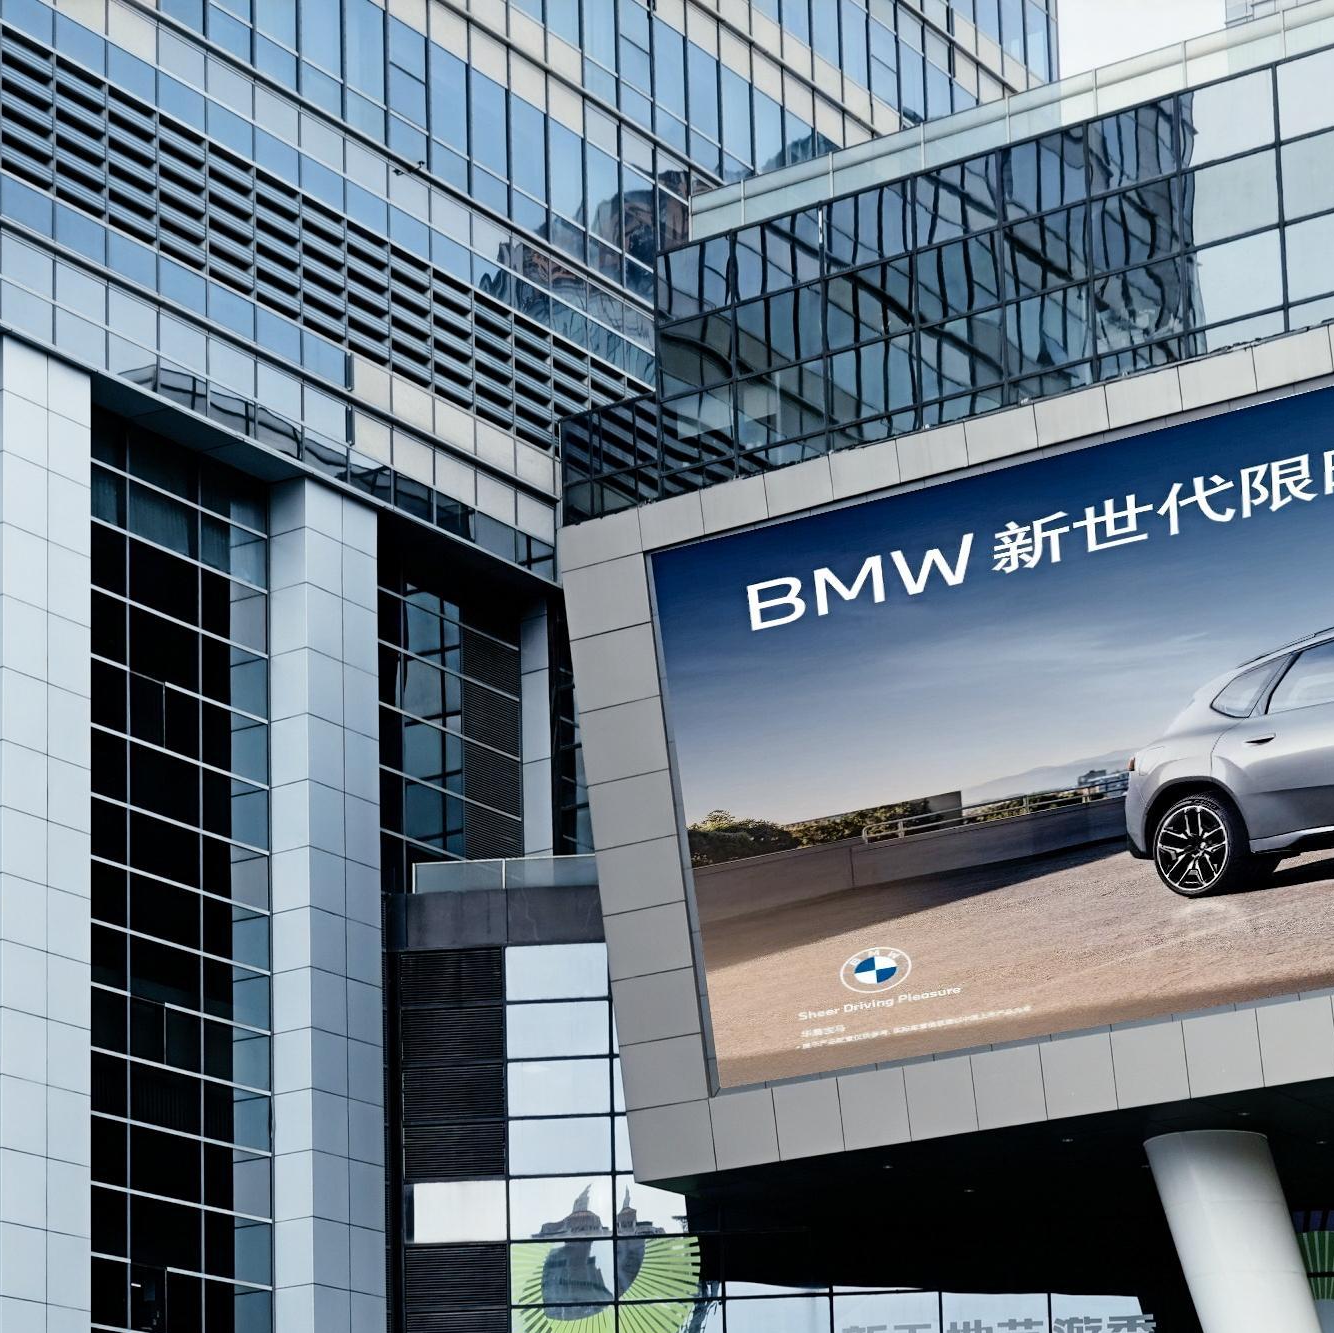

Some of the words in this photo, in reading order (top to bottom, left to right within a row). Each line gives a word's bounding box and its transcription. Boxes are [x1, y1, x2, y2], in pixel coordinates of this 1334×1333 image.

[745, 532, 976, 632] BMW
[798, 1005, 840, 1021] Sheer
[843, 997, 894, 1015] Driving
[897, 984, 962, 1004] Pleasure
